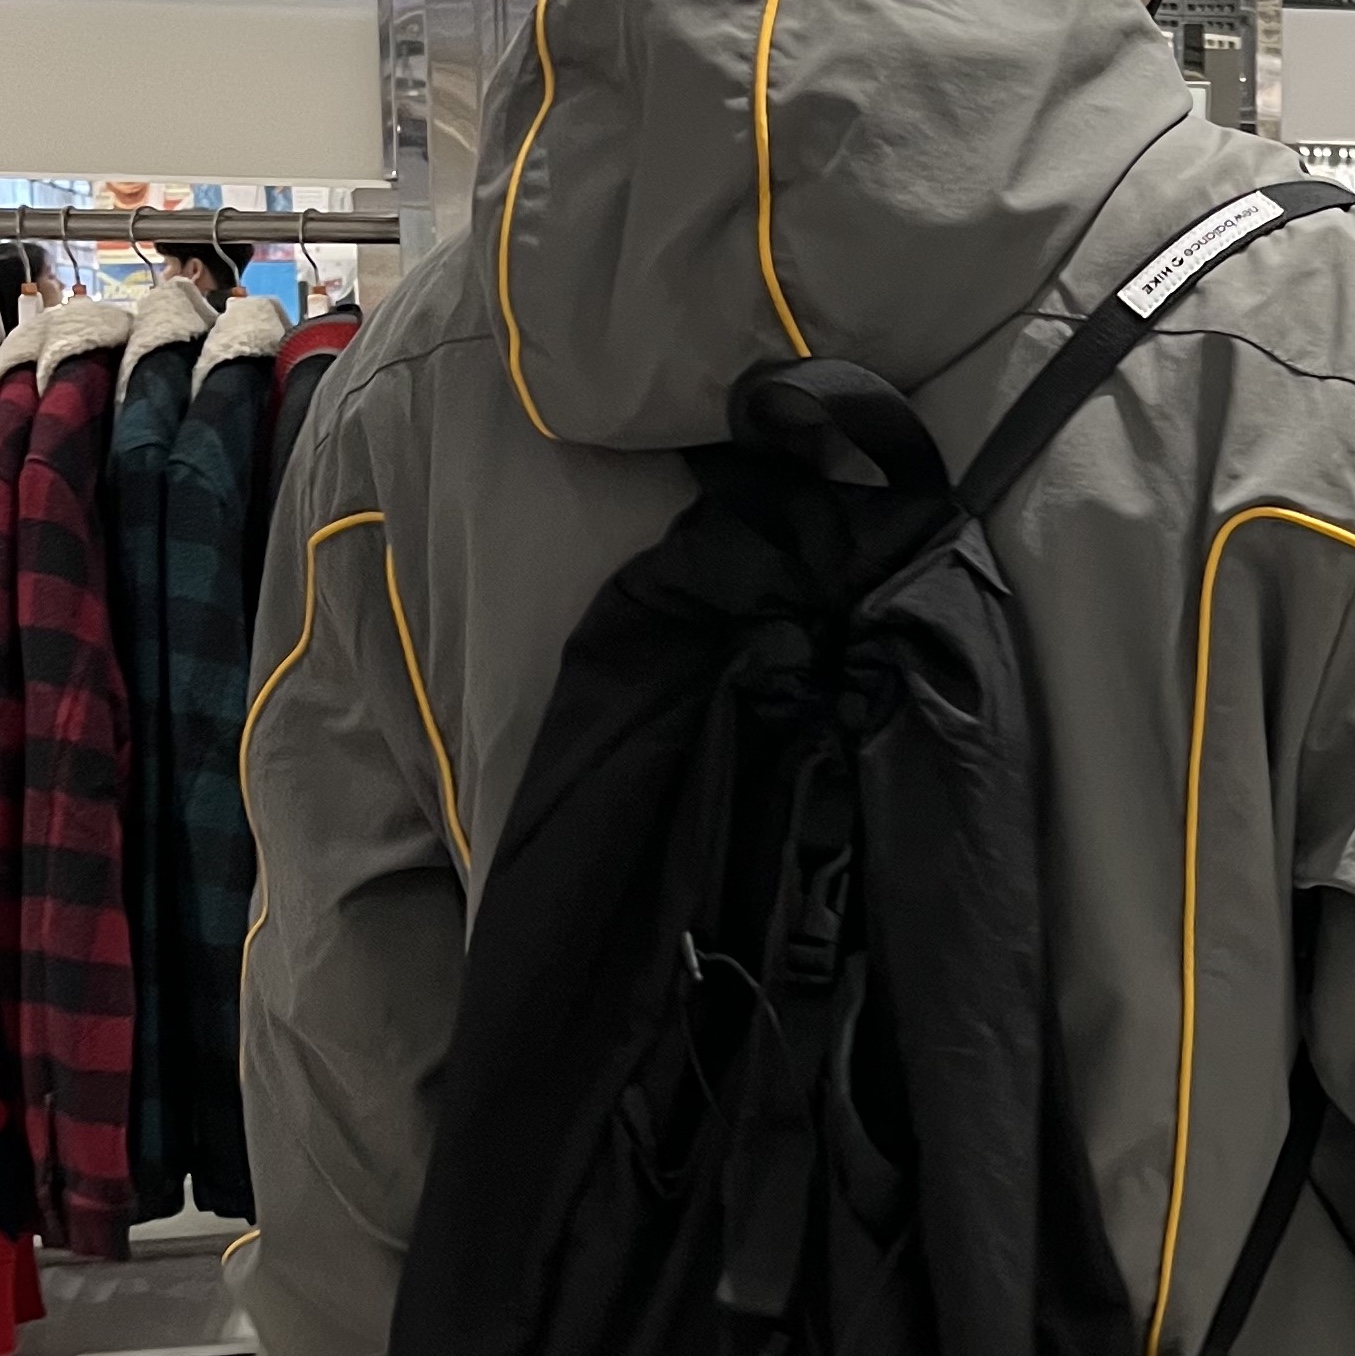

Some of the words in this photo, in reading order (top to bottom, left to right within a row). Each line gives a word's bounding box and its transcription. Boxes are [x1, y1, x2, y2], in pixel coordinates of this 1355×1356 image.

[1234, 205, 1259, 223] new
[1183, 219, 1236, 257] balance
[1141, 266, 1173, 295] HIKE
